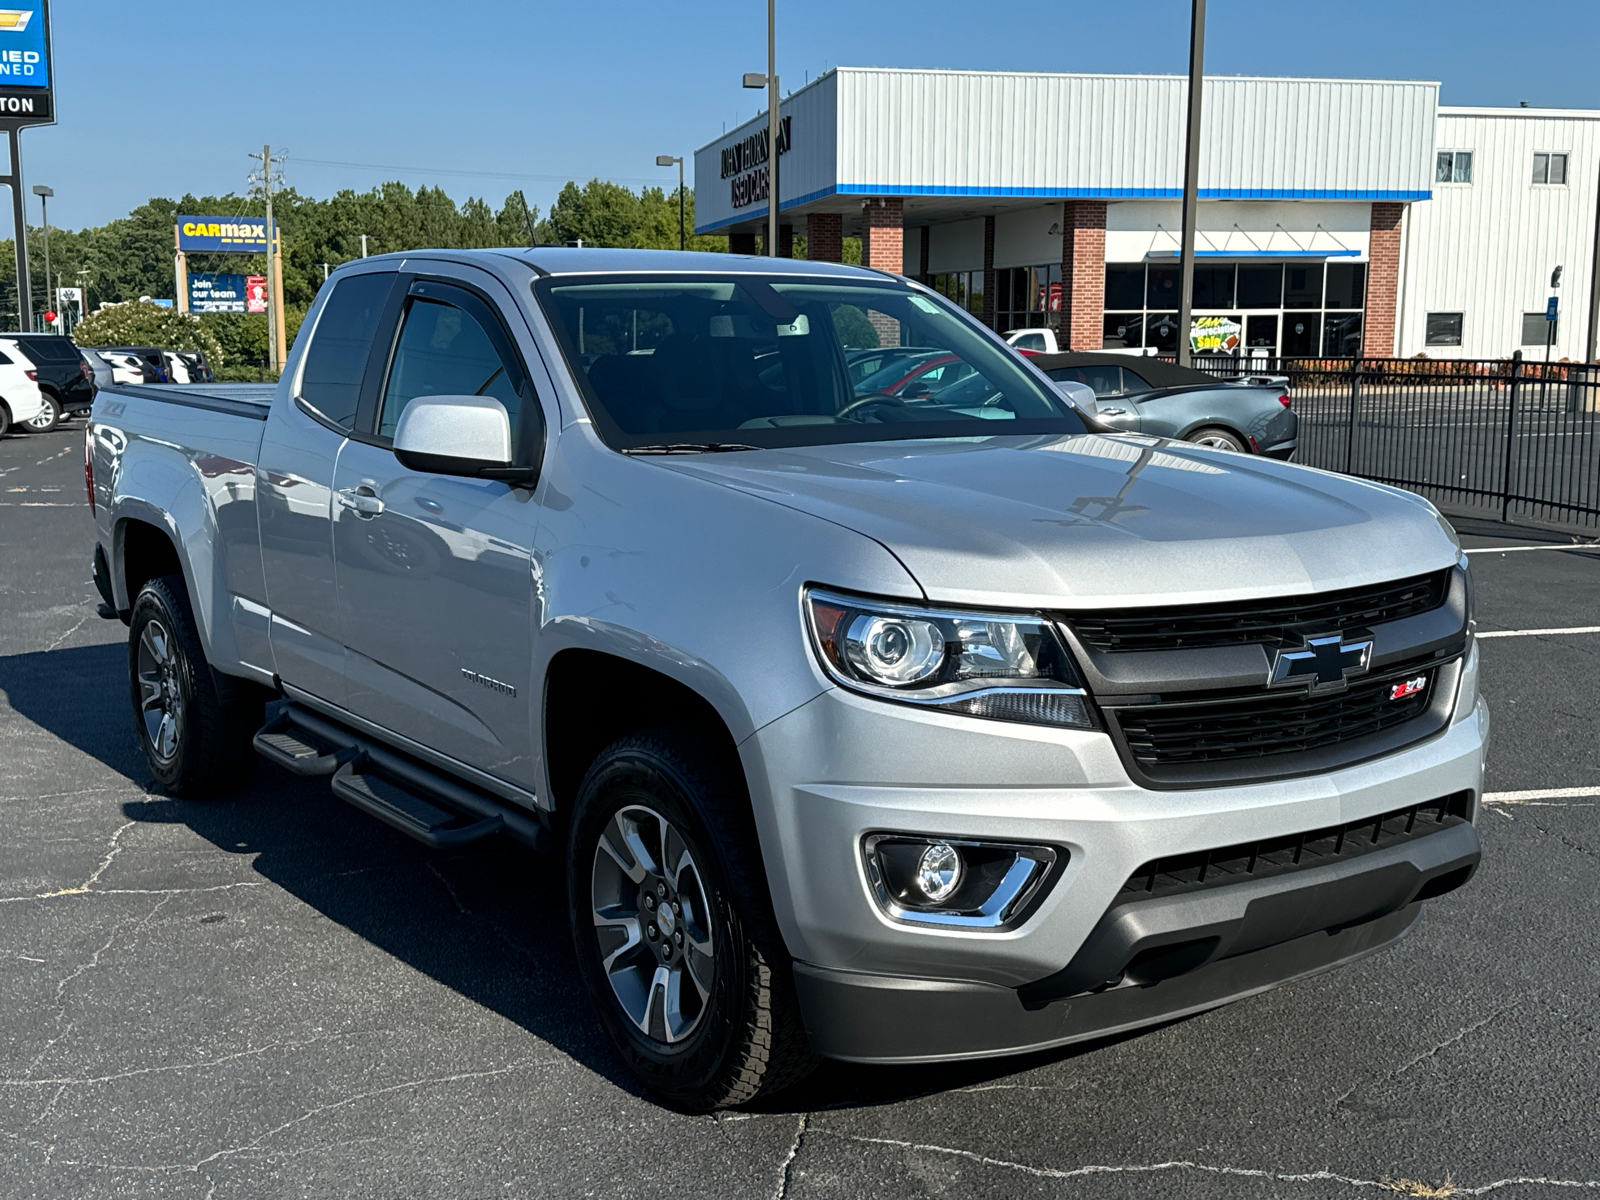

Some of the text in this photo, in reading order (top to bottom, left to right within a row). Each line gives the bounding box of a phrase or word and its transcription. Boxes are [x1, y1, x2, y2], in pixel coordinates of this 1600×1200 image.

[1, 50, 40, 63] IED
[0, 63, 35, 76] NED
[0, 97, 34, 113] TON
[739, 115, 792, 171] THORNN
[731, 174, 750, 209] USED
[192, 279, 212, 289] Join
[192, 289, 237, 298] our team
[1195, 316, 1224, 328] FAN
[1197, 336, 1221, 349] Sale
[1390, 676, 1427, 700] Z71
